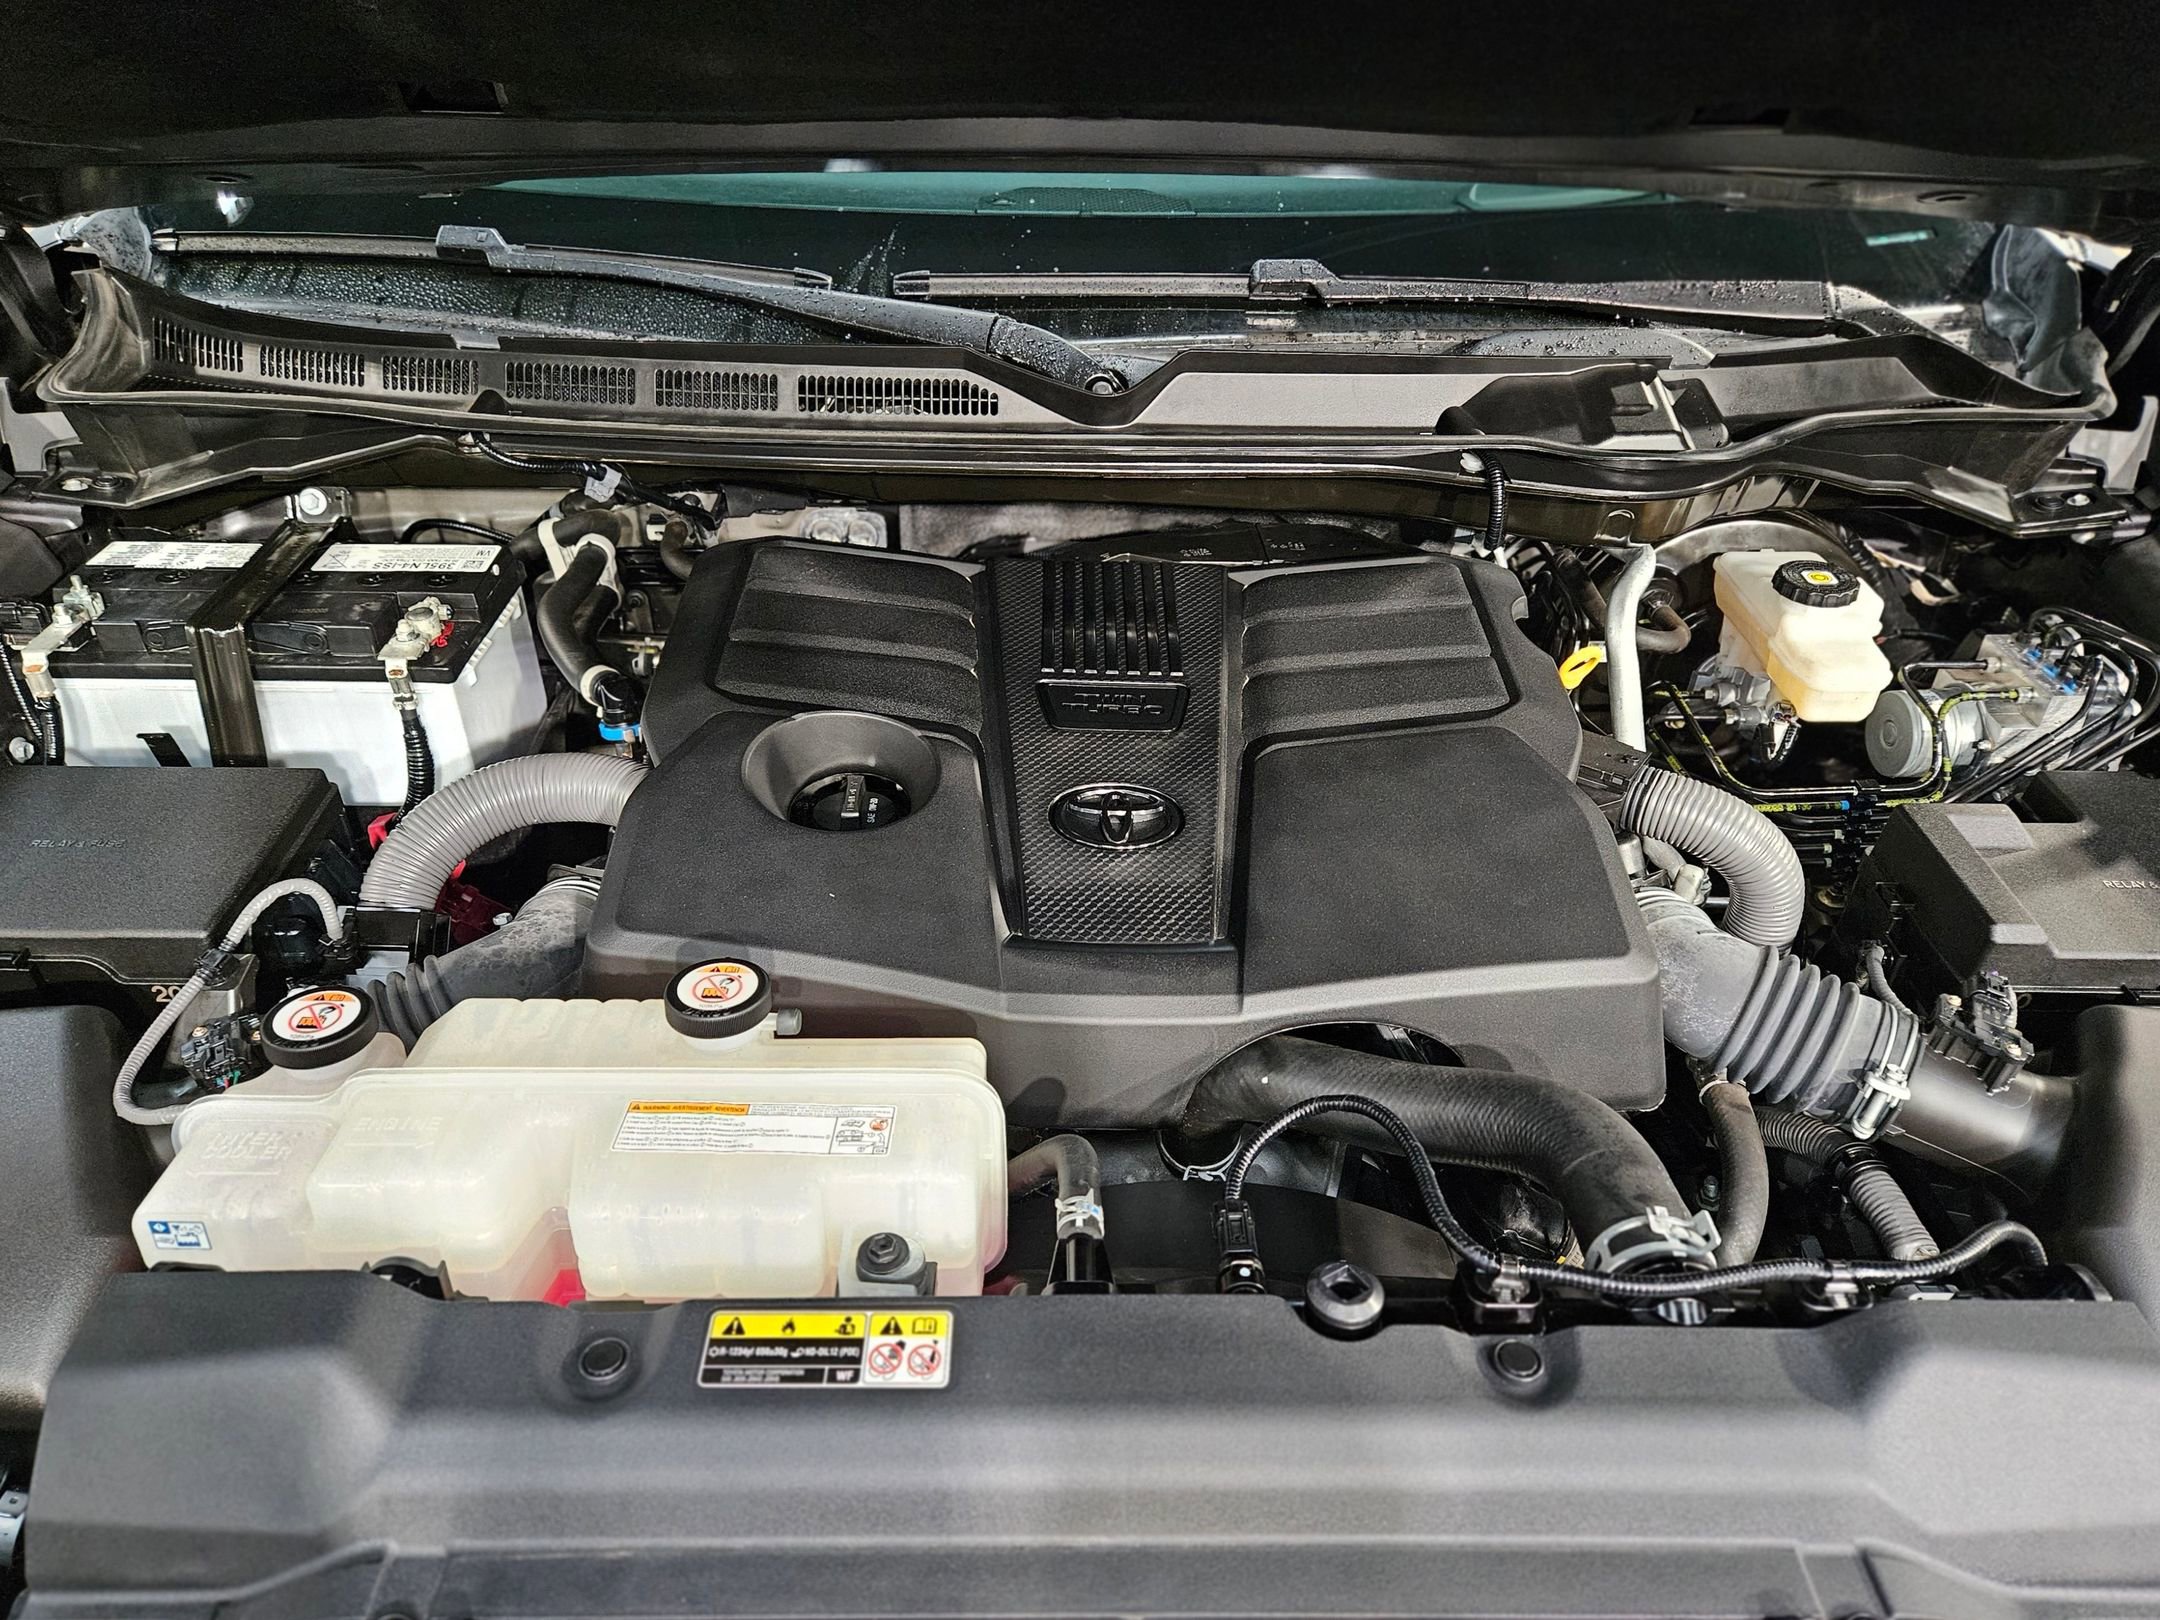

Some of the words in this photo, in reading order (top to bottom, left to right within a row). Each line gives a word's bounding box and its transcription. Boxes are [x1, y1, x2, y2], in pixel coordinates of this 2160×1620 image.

[373, 561, 455, 570] 395LN4-ISS
[1074, 693, 1146, 703] TWIN
[1061, 702, 1163, 715] TURBO
[866, 813, 876, 823] SAE
[31, 840, 75, 848] RELAY
[90, 840, 126, 848] FUSE
[2103, 880, 2147, 889] RELAY
[642, 1103, 671, 1111] WARNING
[353, 1116, 443, 1132] ENGINE
[207, 1131, 283, 1147] INTER
[201, 1145, 292, 1160] COOLER
